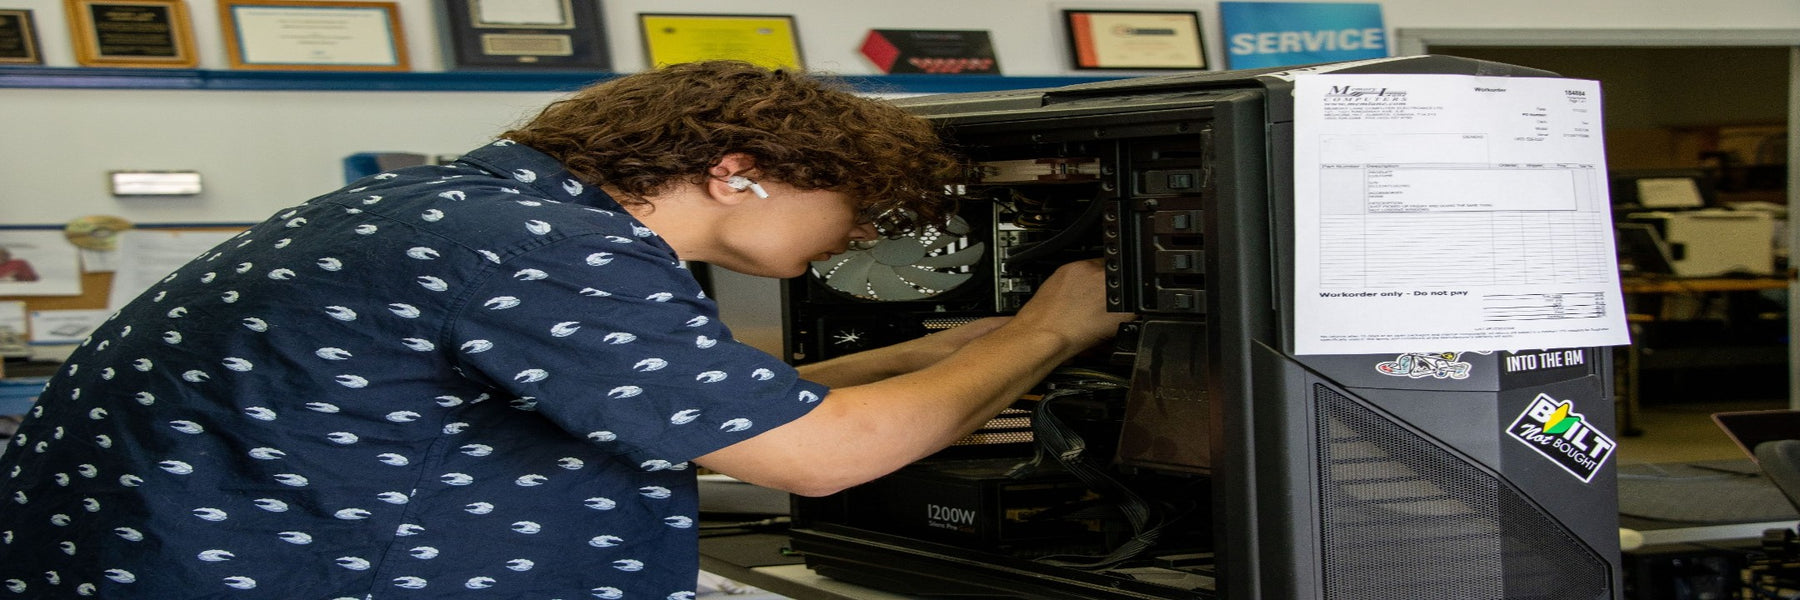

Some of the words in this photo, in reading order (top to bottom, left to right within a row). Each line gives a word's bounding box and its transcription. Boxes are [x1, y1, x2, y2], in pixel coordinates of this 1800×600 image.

[1230, 28, 1384, 55] SERVICE
[1506, 354, 1537, 372] INTO
[1538, 351, 1563, 369] THE
[1564, 349, 1584, 366] AM
[1528, 398, 1612, 459] BILT
[1520, 423, 1554, 445] Not
[1552, 438, 1598, 471] BOUGHT
[928, 503, 976, 526] 1200W
